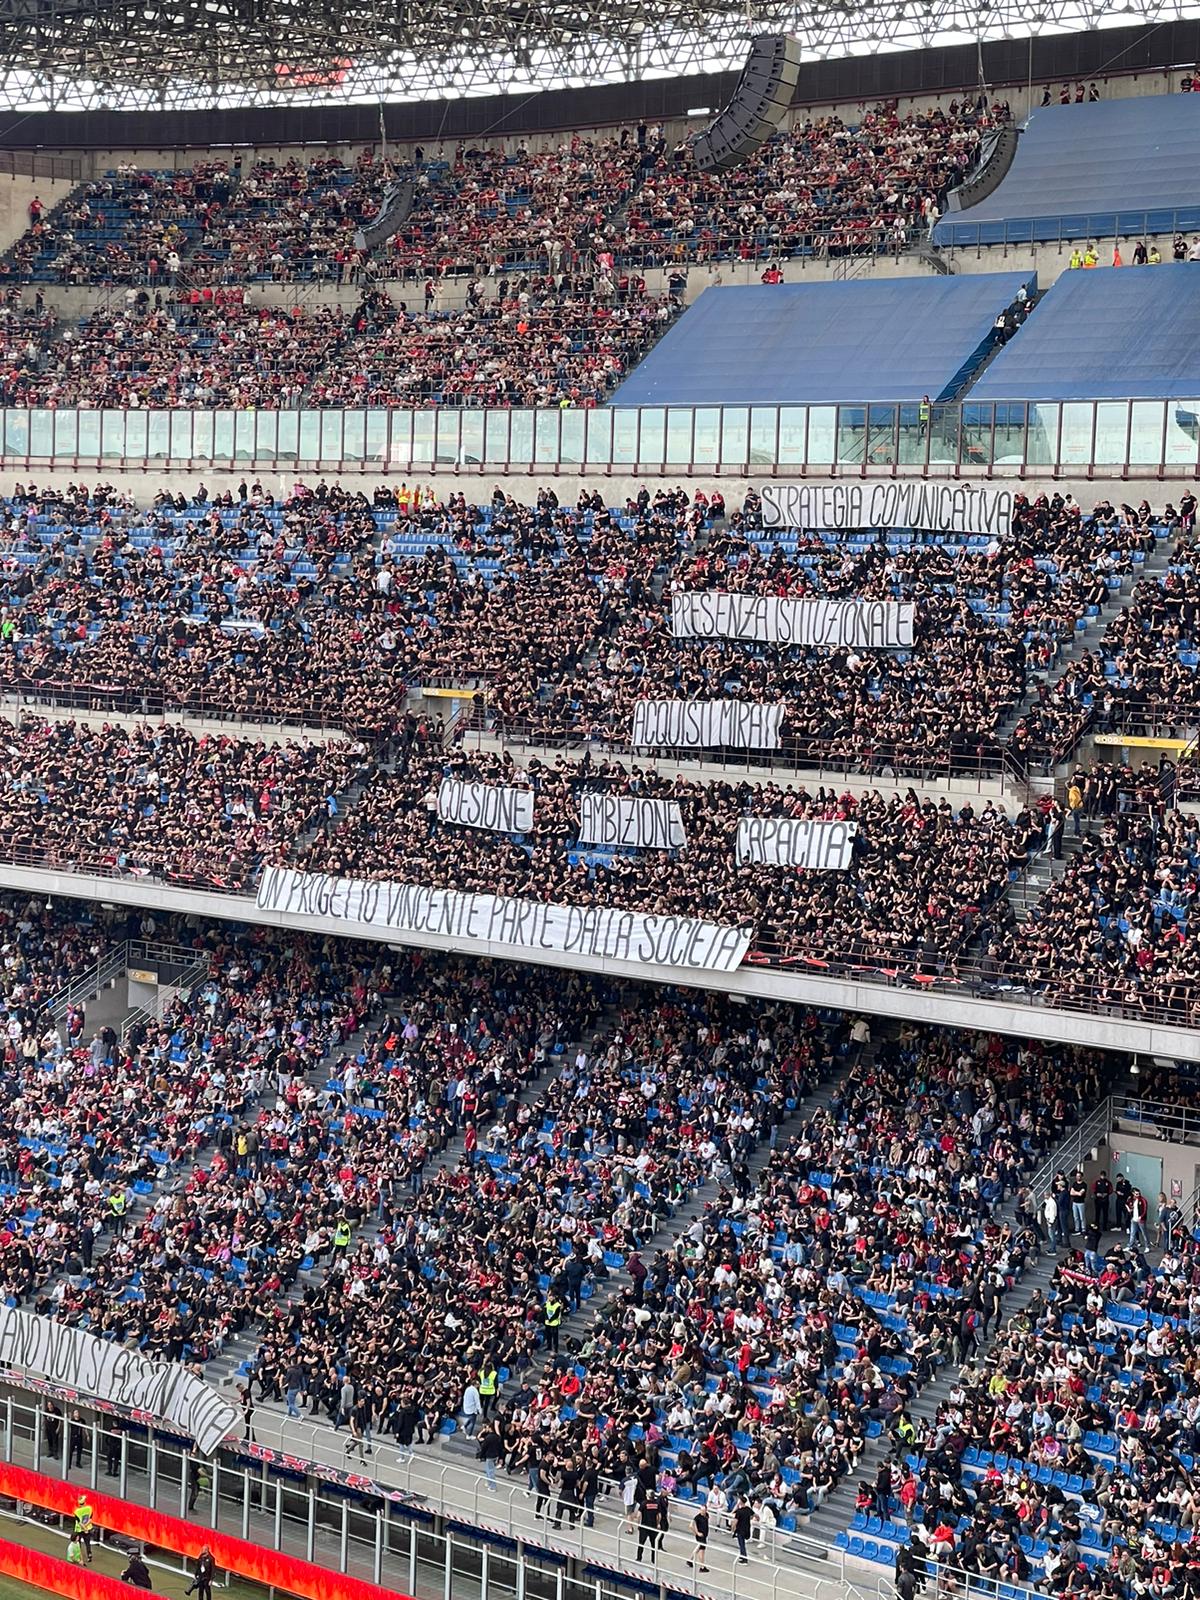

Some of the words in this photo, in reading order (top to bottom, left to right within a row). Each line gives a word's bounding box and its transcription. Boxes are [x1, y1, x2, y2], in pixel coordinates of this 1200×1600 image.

[762, 485, 862, 528] STRATEGIA
[869, 483, 1013, 534] COMUNICATIVA
[672, 592, 768, 640] PRESENZA
[775, 598, 915, 646] ISTITUZIONALE
[633, 700, 713, 746] ACQUISTI
[719, 700, 782, 748] MIRATI
[439, 779, 530, 832] COESIONE
[581, 793, 686, 848] AMBIZIONE
[256, 866, 287, 909] UN
[285, 871, 380, 923] PROGETTO
[386, 881, 479, 938] VINCENTE
[487, 895, 554, 949] PARTE
[564, 904, 634, 959] DALLA
[0, 1306, 41, 1368] ANO
[42, 1320, 87, 1385] NON
[86, 1339, 111, 1394] SI
